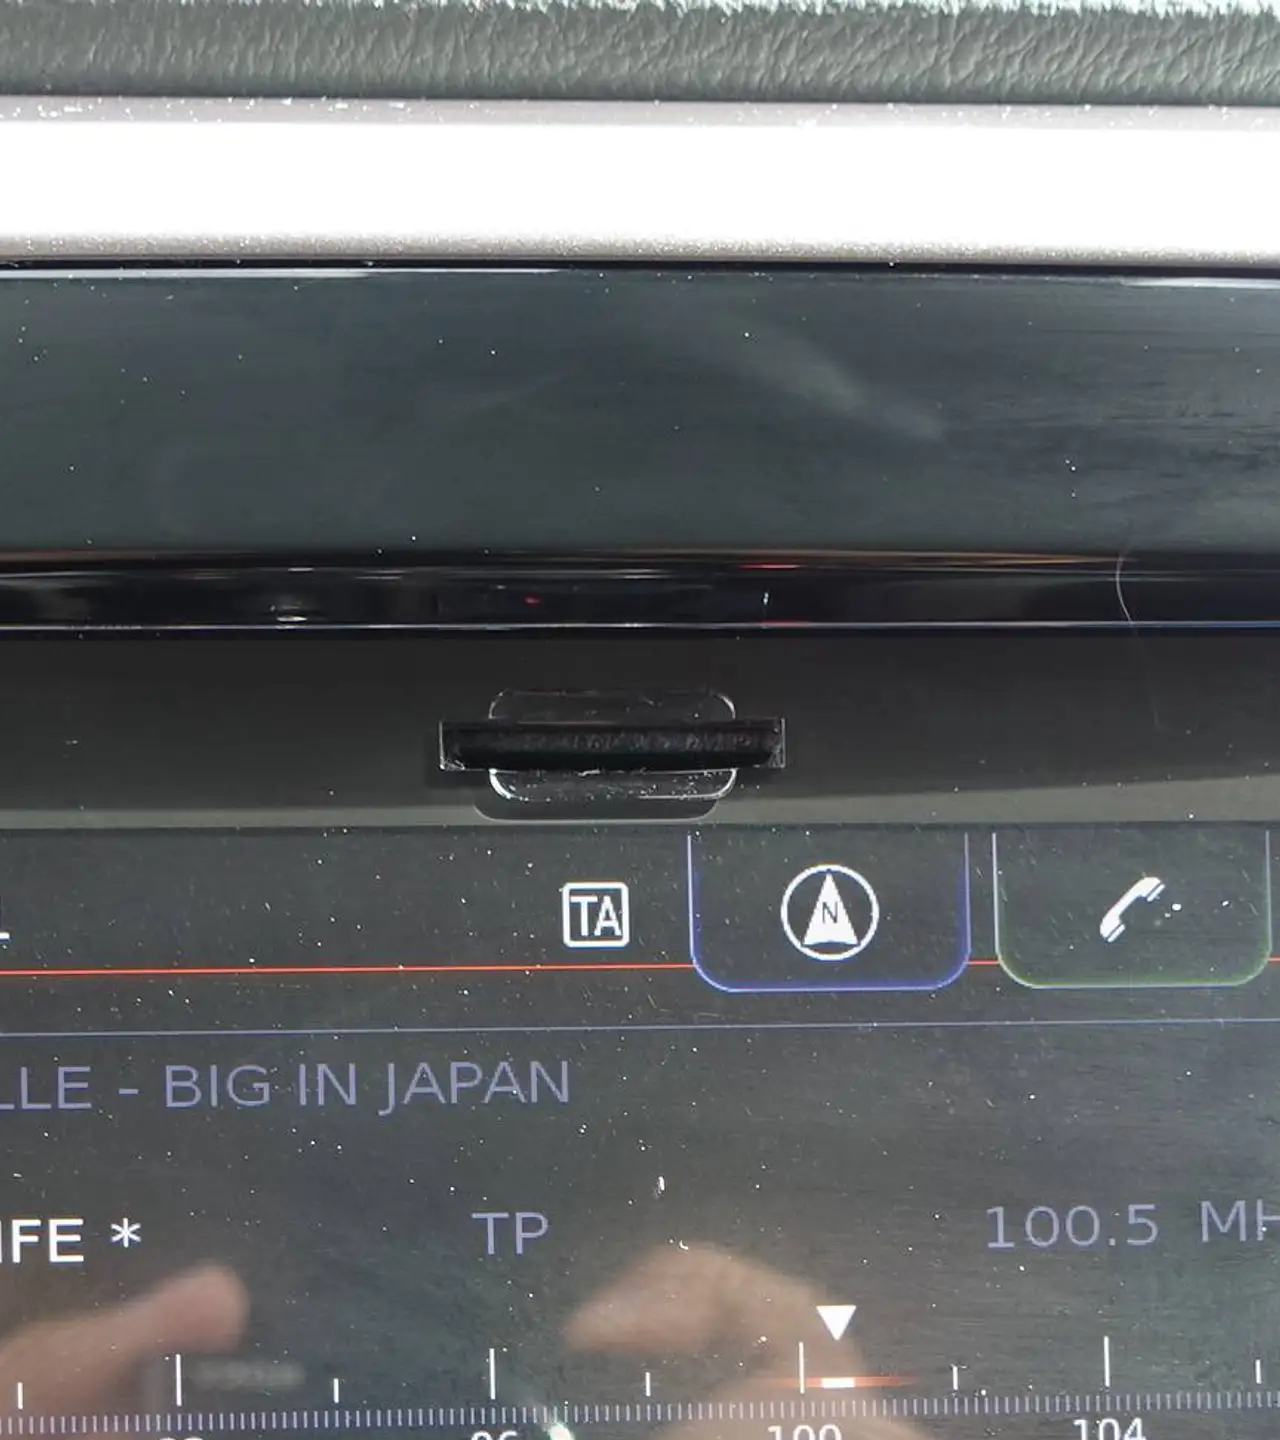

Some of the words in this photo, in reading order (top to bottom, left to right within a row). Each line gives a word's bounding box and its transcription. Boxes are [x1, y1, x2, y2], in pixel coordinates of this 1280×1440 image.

[570, 895, 622, 937] TA
[165, 1064, 271, 1109] BIG
[298, 1062, 357, 1107] IN
[378, 1060, 570, 1116] JAPAN
[471, 1211, 550, 1256] TP
[984, 1203, 1160, 1250] 100.5
